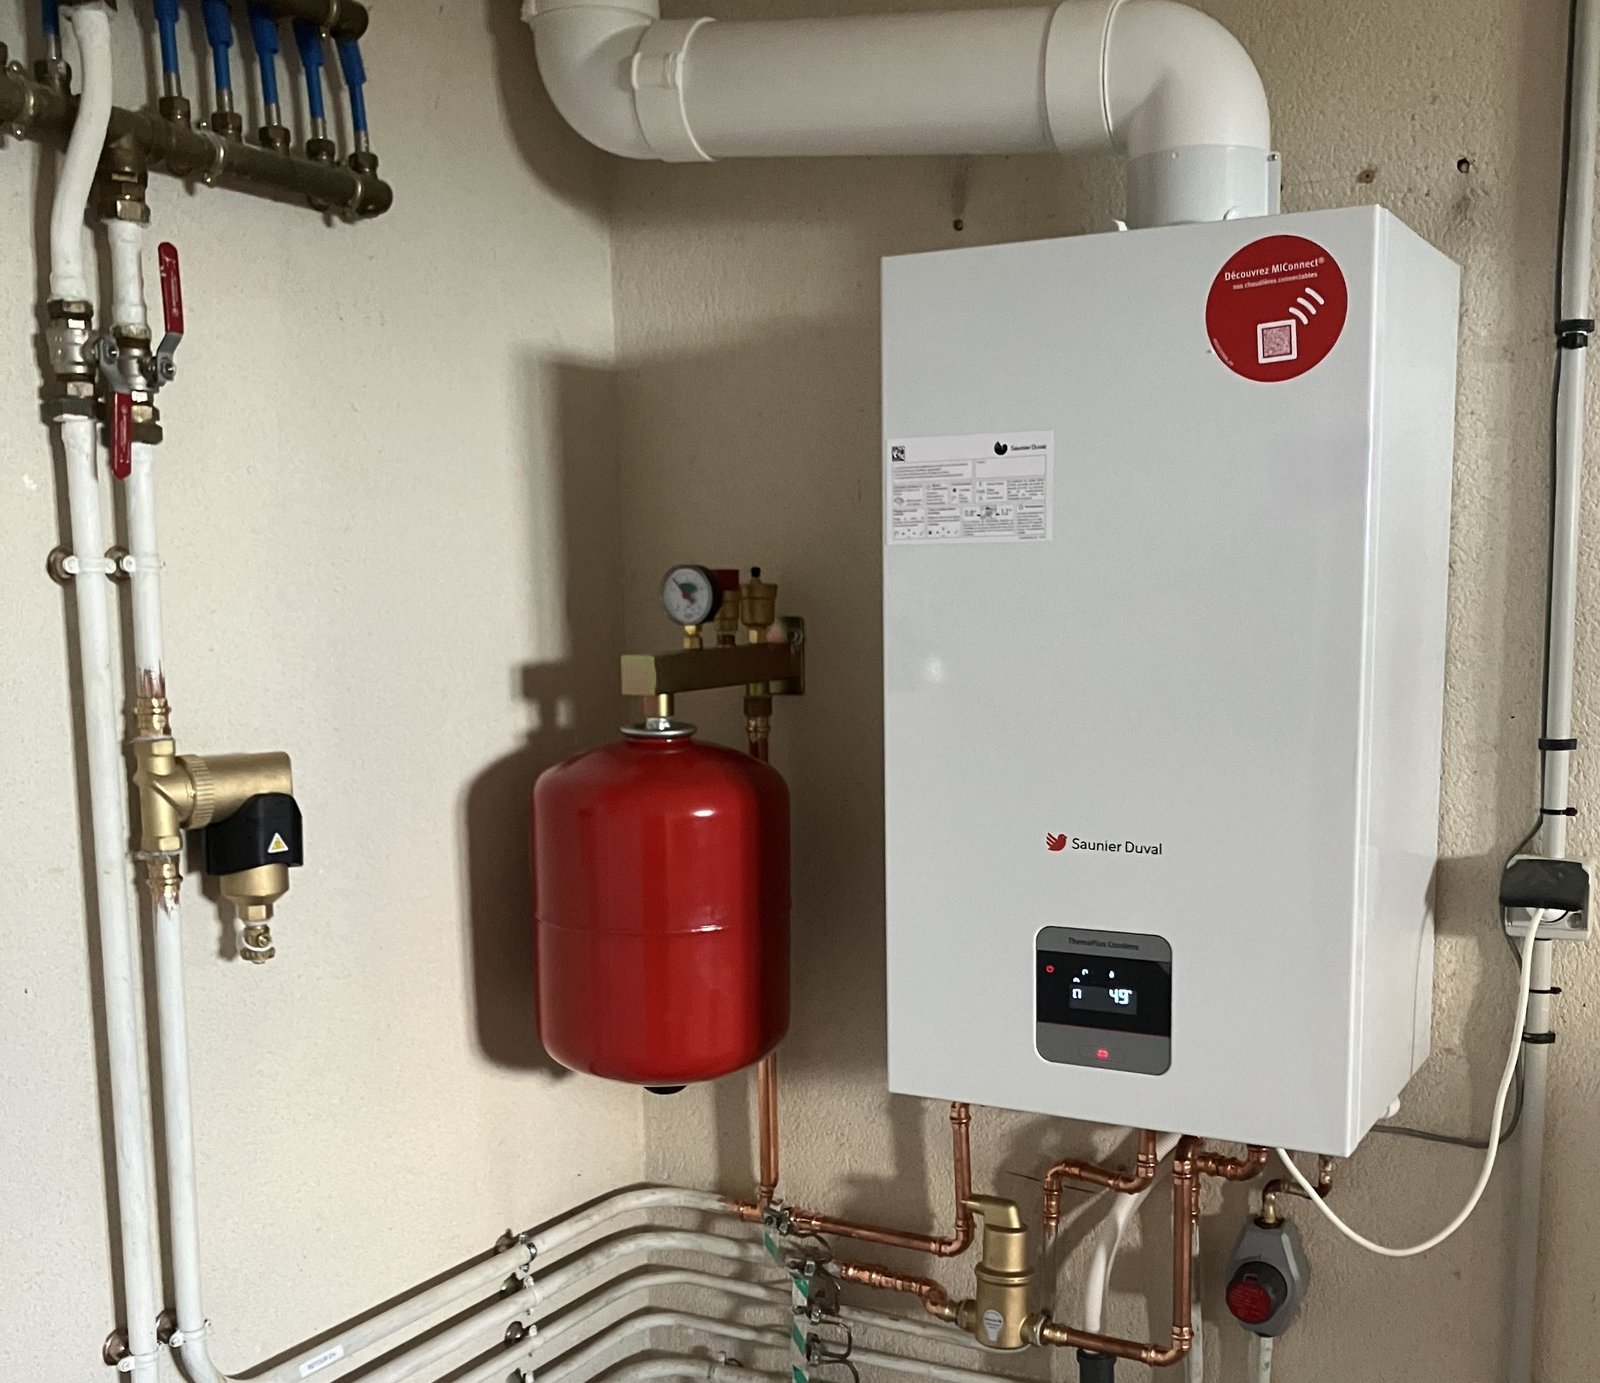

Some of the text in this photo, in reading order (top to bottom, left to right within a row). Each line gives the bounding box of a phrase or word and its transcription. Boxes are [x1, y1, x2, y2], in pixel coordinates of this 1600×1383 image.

[1224, 267, 1269, 281] Découvrez
[1071, 837, 1163, 855] Saunier Duval
